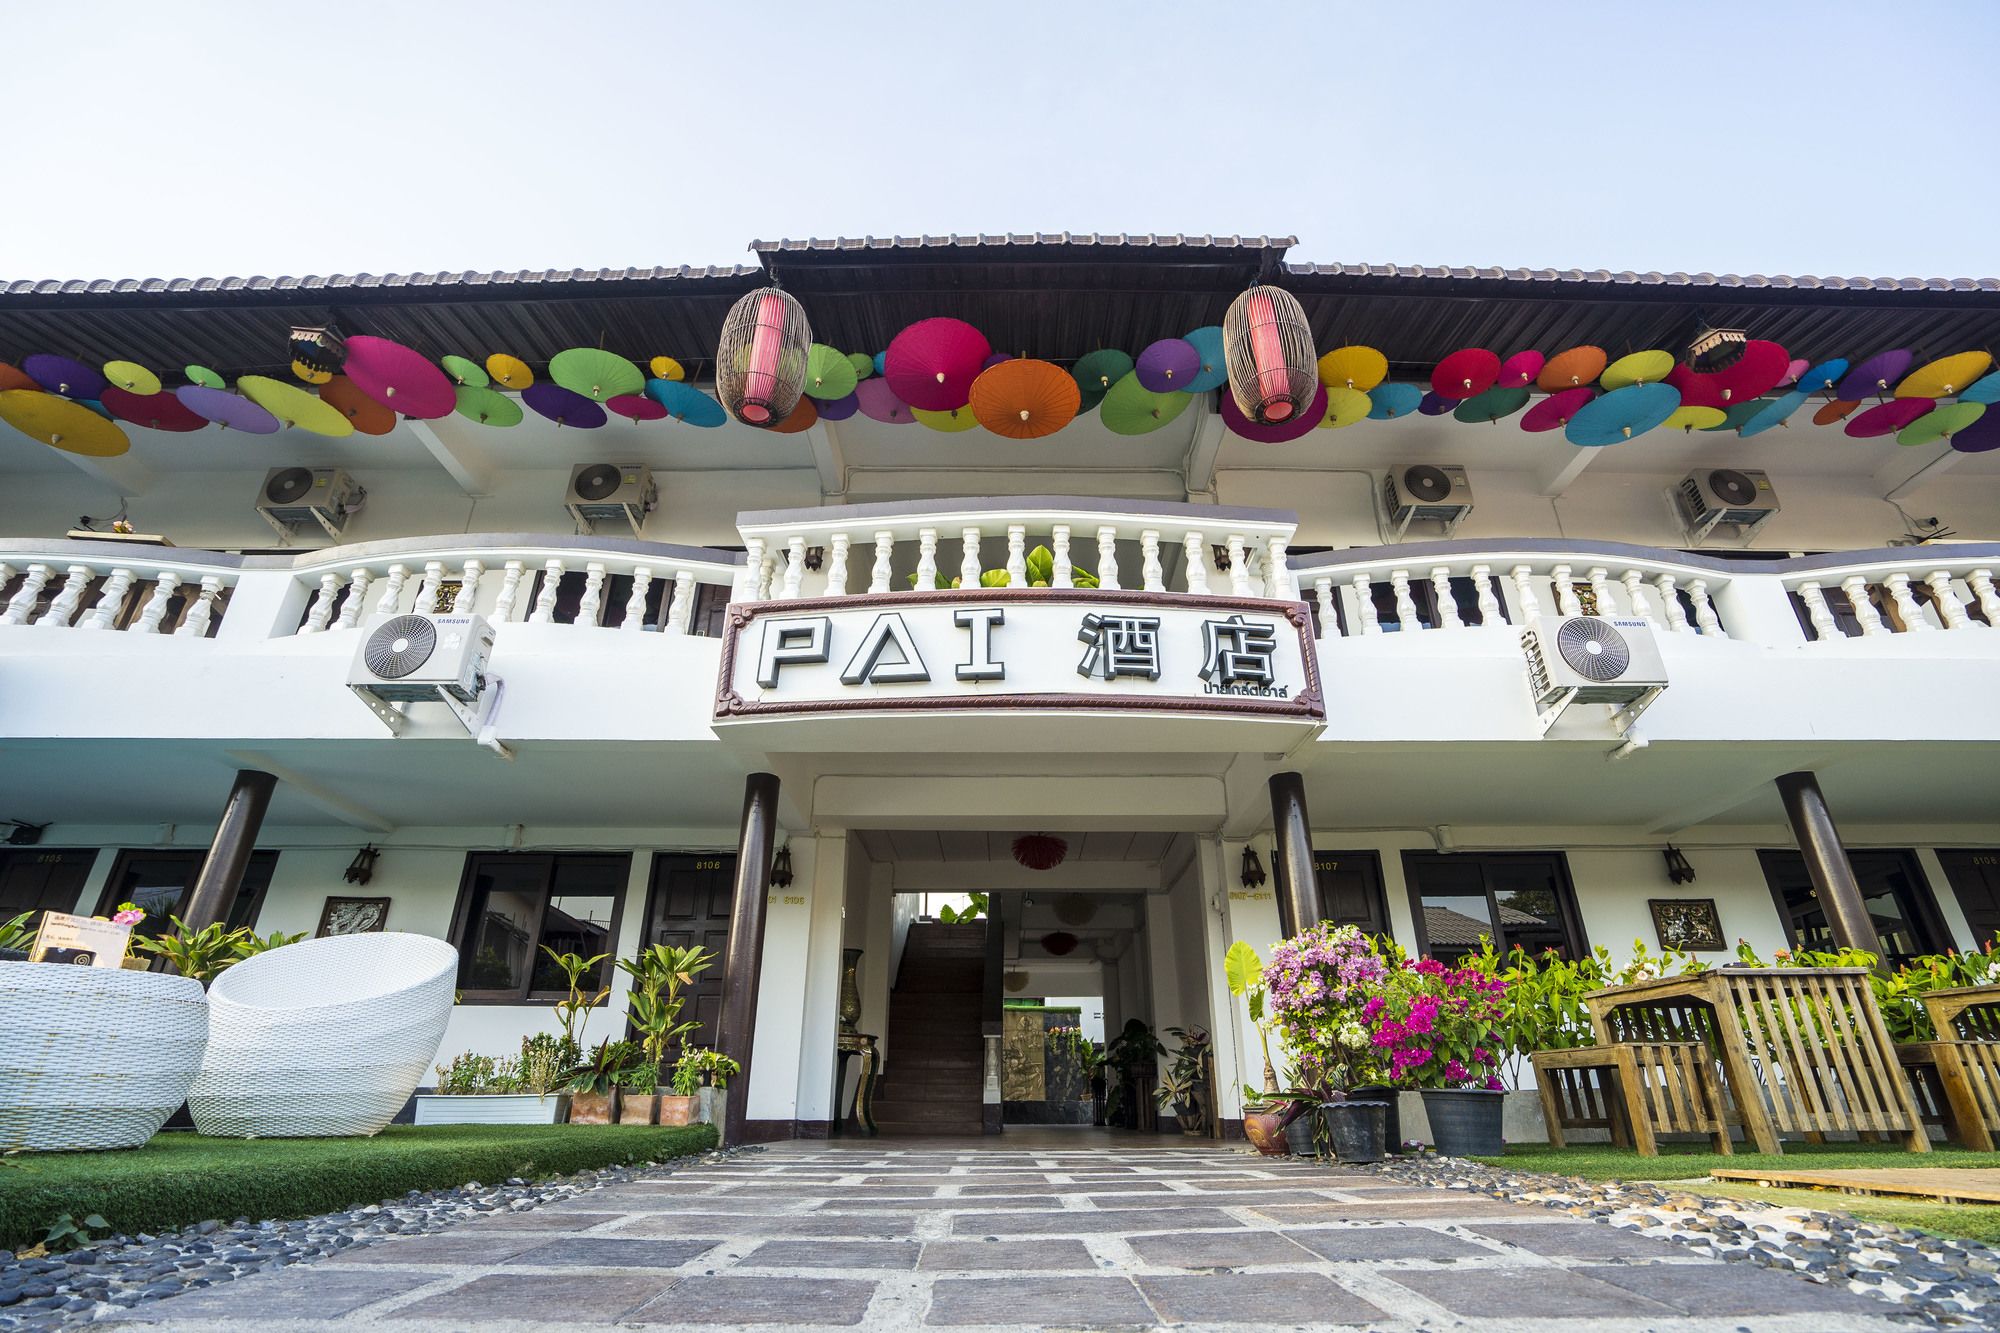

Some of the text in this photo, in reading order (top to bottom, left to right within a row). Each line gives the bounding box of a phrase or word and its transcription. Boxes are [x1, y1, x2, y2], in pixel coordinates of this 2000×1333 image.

[757, 608, 1275, 688] PAI 酒店
[696, 861, 721, 870] 8106
[1314, 862, 1338, 871] 8107
